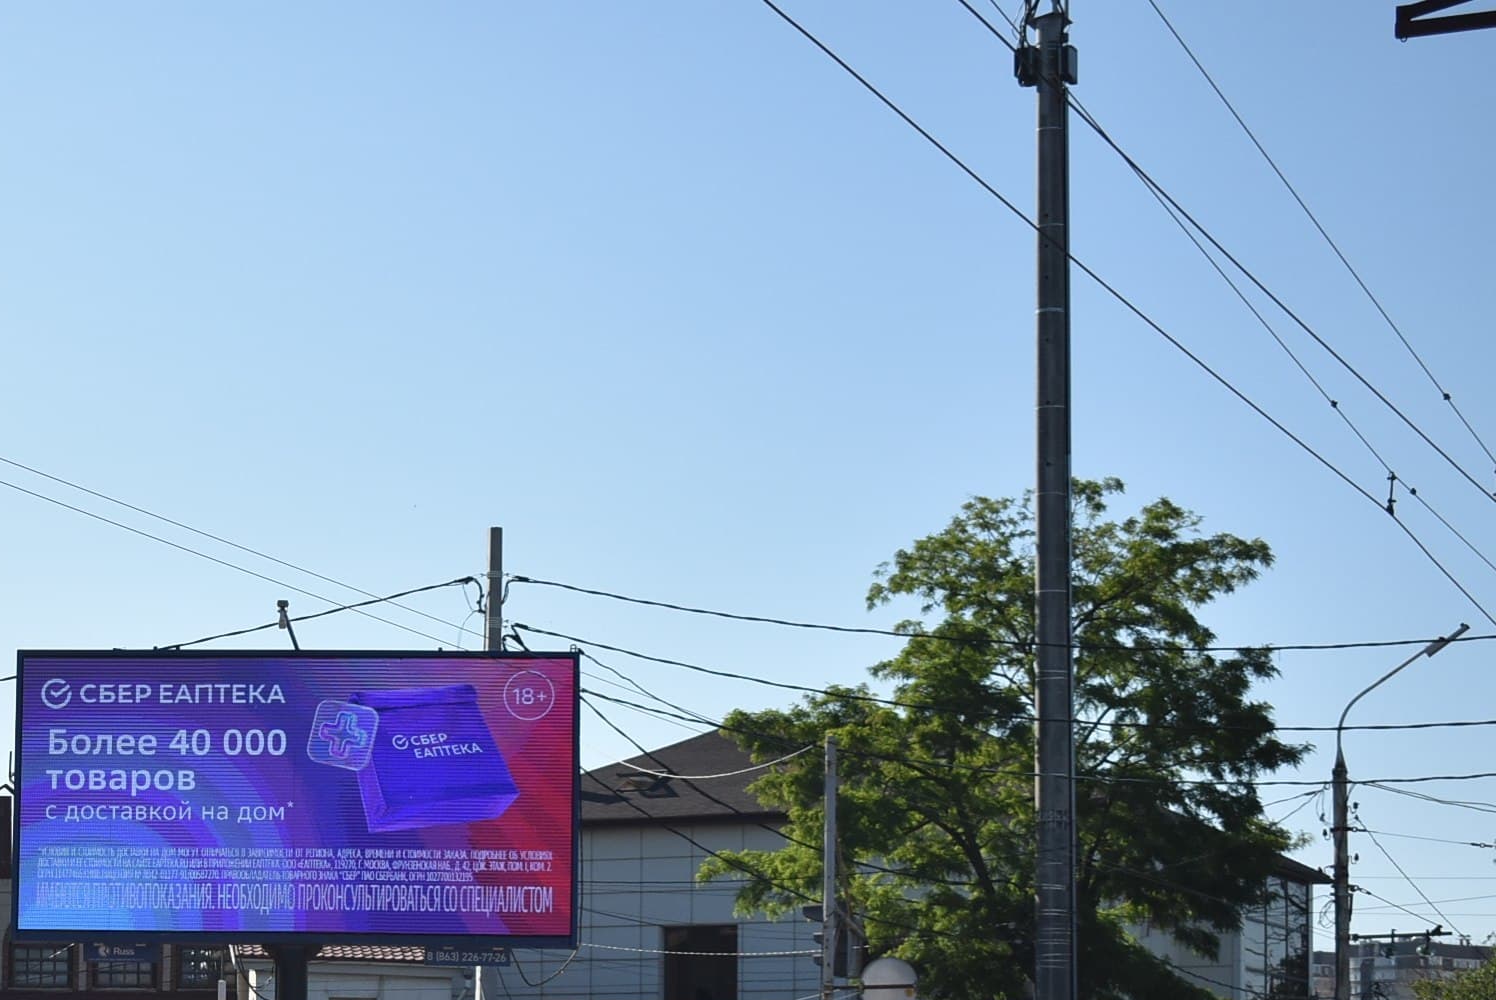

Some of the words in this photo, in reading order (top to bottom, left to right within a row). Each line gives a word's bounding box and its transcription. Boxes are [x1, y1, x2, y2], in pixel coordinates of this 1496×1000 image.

[79, 683, 152, 704] СБЕР
[158, 683, 286, 704] ЕАПТЕКА
[511, 687, 547, 706] 18+
[48, 728, 158, 756] Более
[168, 729, 212, 756] 40
[223, 729, 288, 756] 000
[410, 732, 448, 747] СБЕР
[414, 742, 484, 760] ЕАПТЕКА
[45, 769, 196, 797] товаров
[45, 804, 57, 821] с
[64, 800, 193, 823] доставкой
[201, 804, 229, 821] на
[217, 883, 296, 916] НЕОБХОДИМО
[297, 884, 442, 912] ПРОКОНСУЛЬТИРОВАТЬСЯ
[443, 885, 458, 912] СО
[460, 885, 553, 919] СПЕЦИАЛИСТОМ
[112, 946, 135, 956] Russ
[426, 951, 433, 961] 8
[435, 951, 460, 963] (863)
[461, 952, 507, 963] 226-77-26
